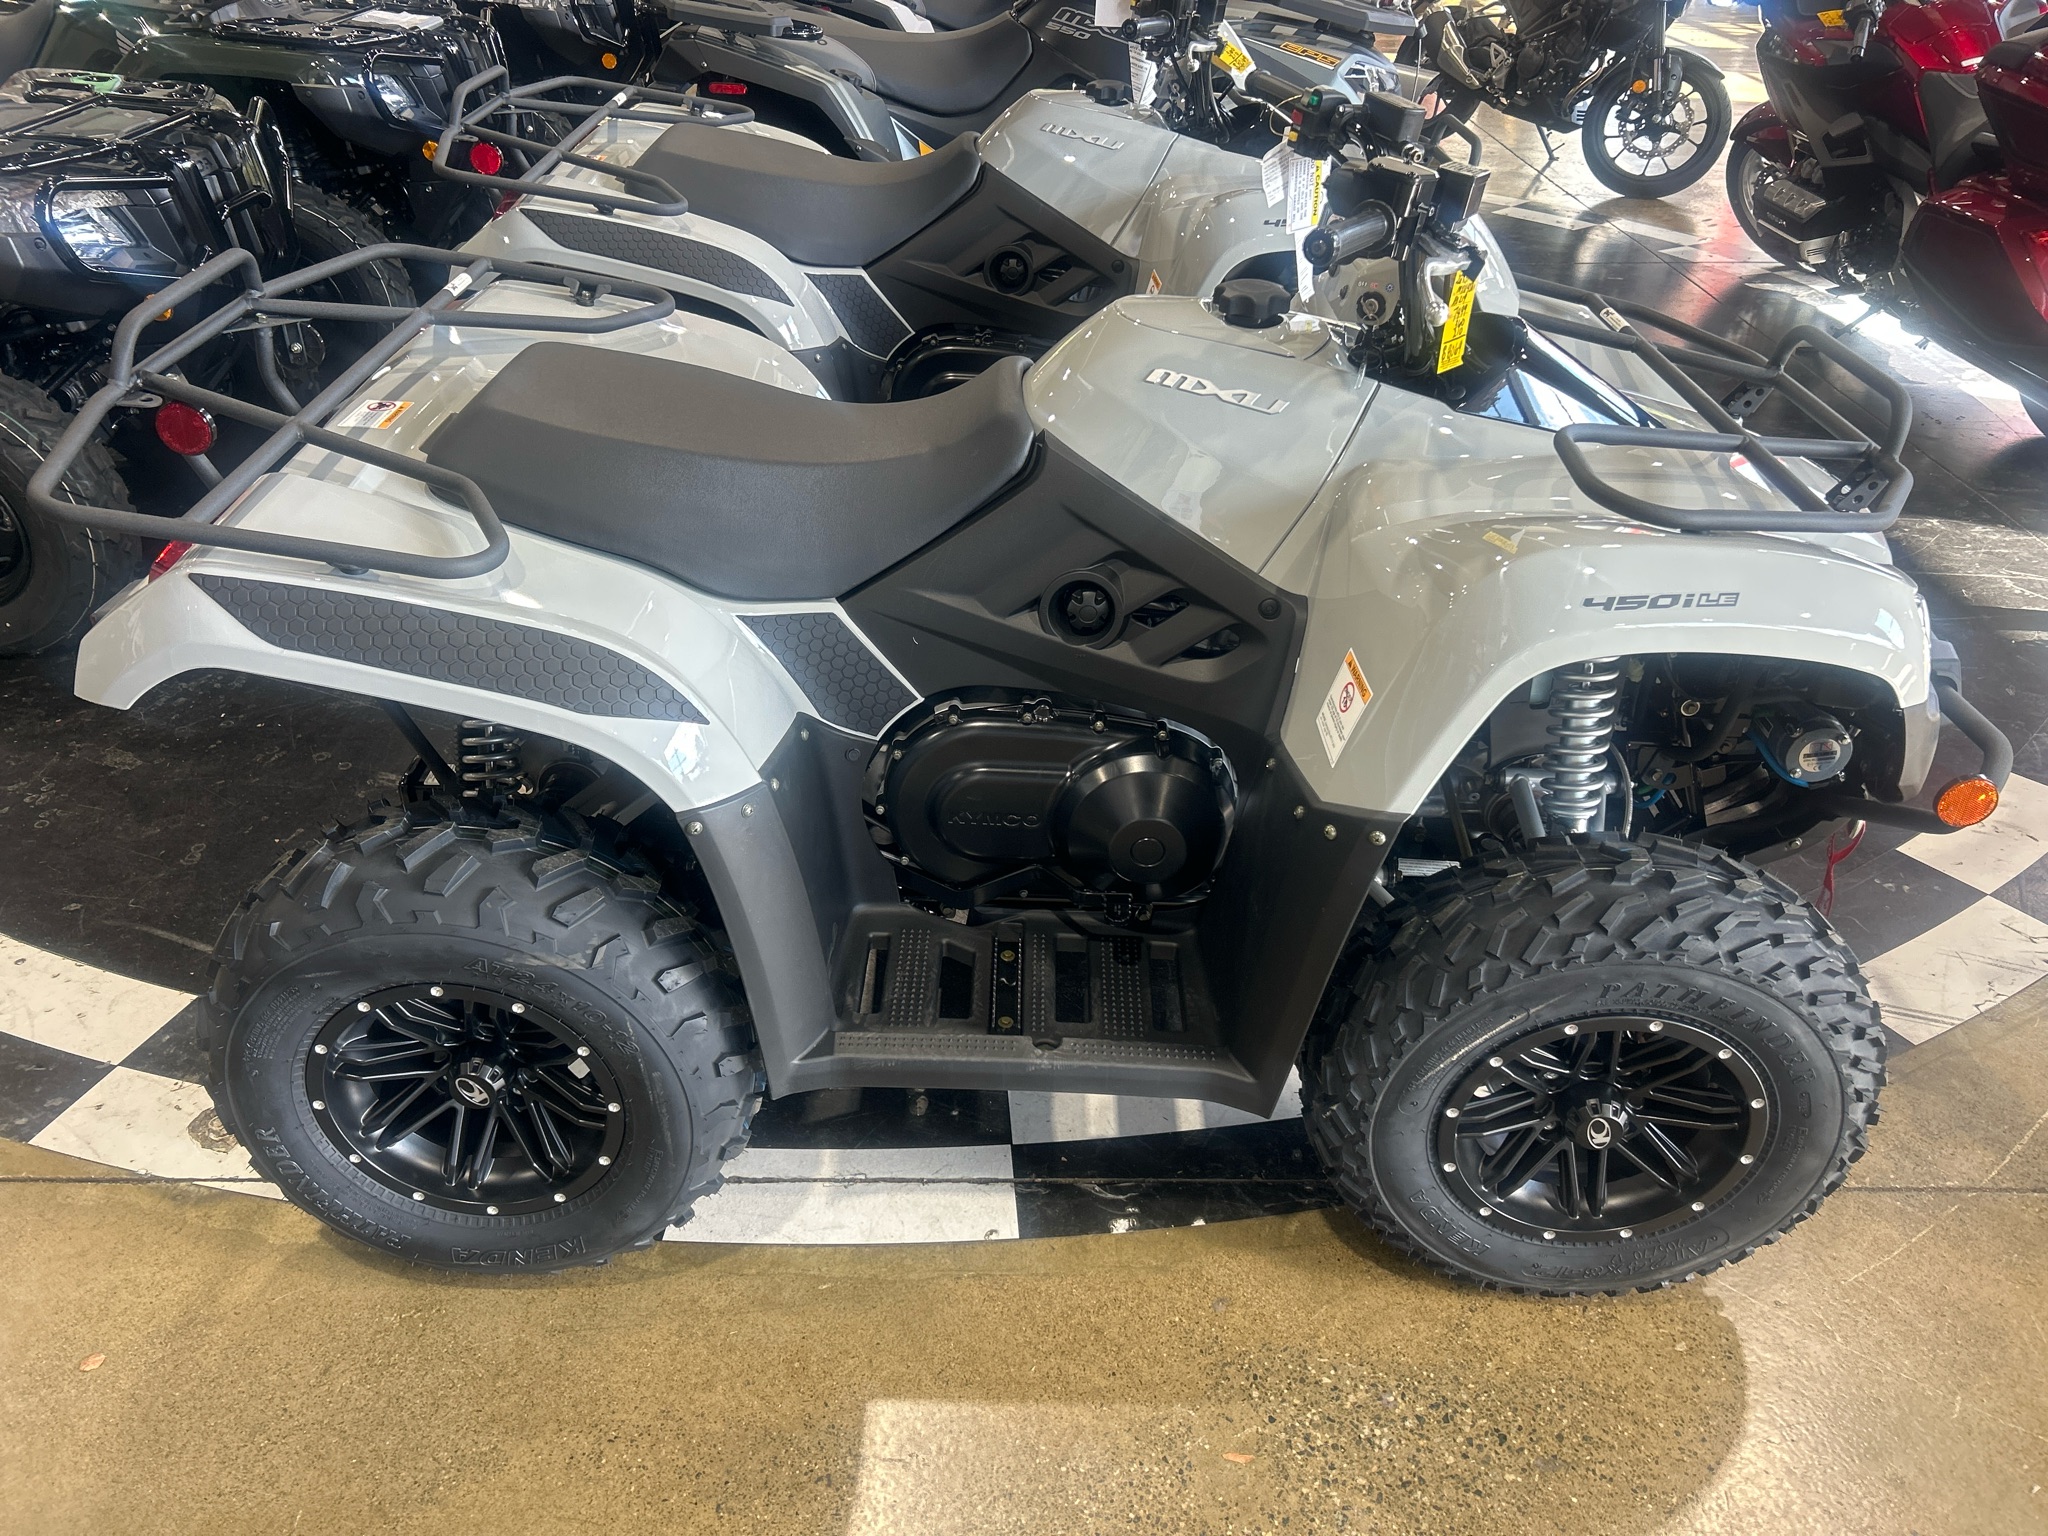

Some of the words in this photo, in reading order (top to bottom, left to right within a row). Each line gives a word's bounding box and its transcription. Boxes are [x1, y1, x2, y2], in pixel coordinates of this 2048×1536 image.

[1045, 21, 1091, 39] 550
[1313, 174, 1321, 216] CAUTION
[1350, 665, 1368, 698] WARNING
[948, 811, 1041, 828] KYMCO
[1599, 981, 1817, 1085] PATHFINDER
[254, 1126, 412, 1249] PATHFINDER
[1409, 1188, 1491, 1256] KENDA
[452, 1235, 586, 1266] KENDA
